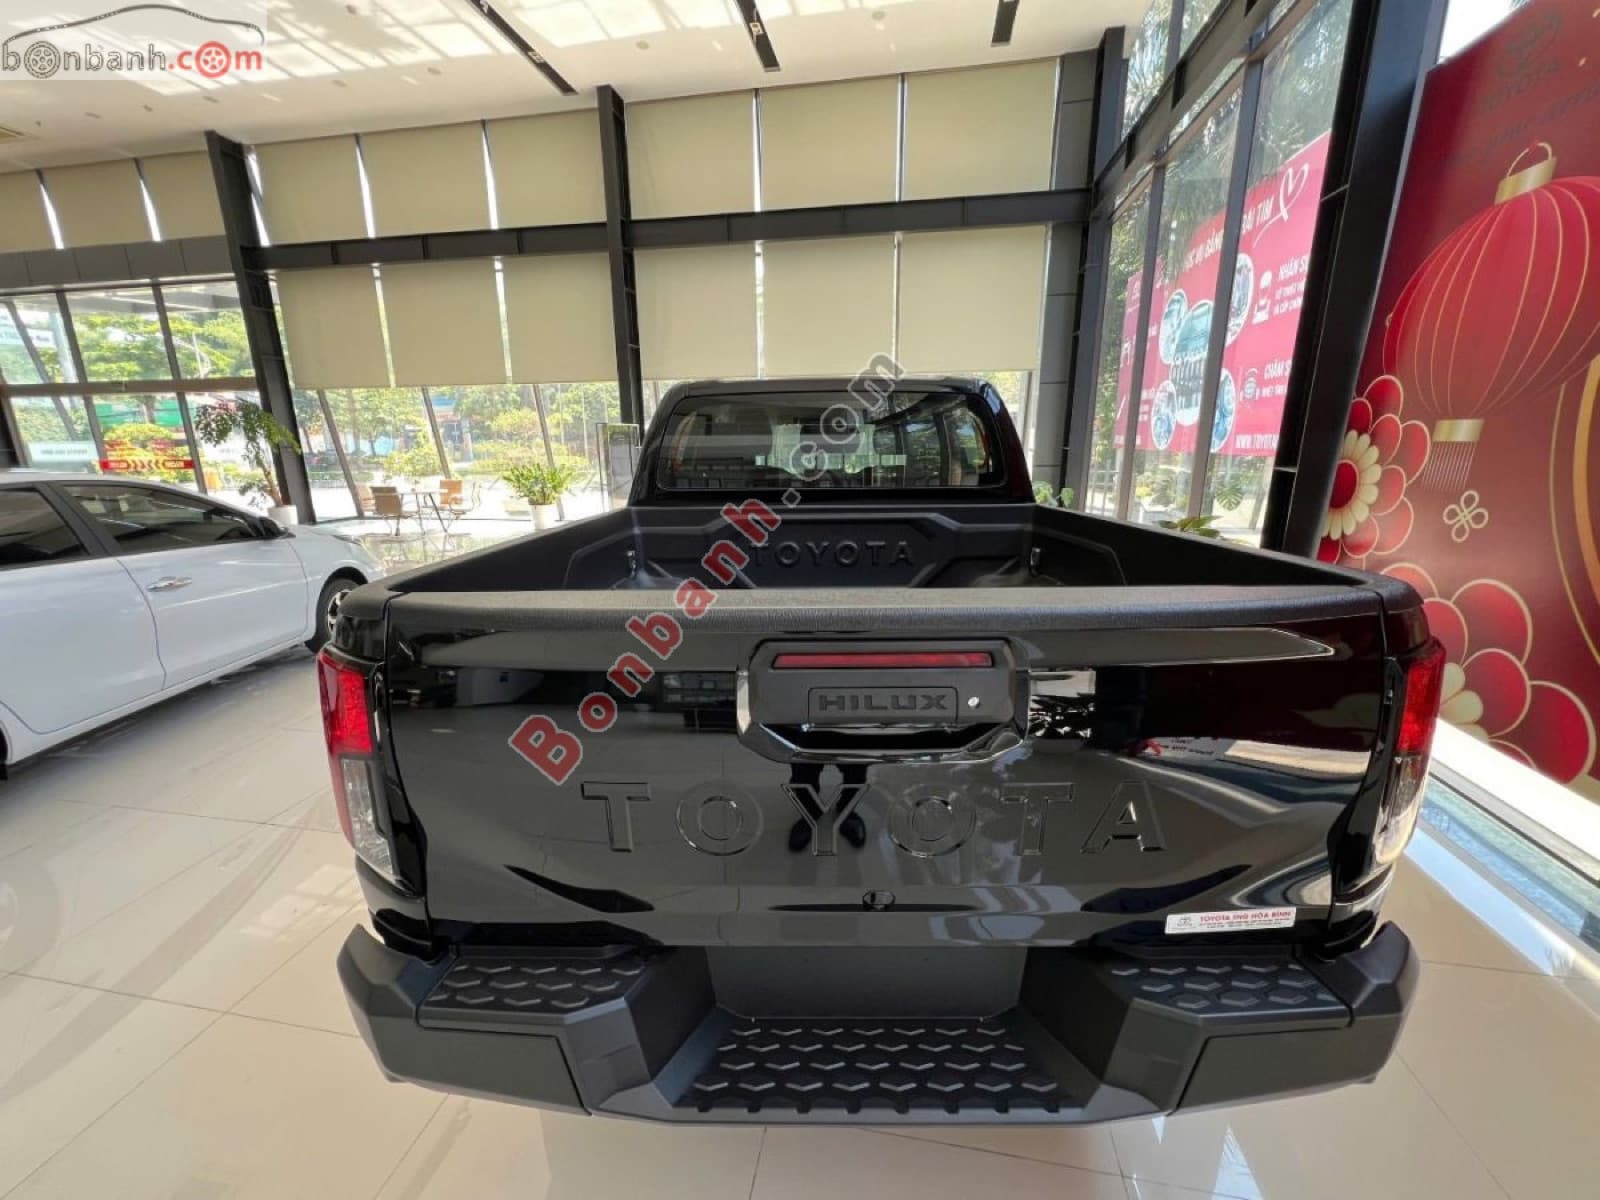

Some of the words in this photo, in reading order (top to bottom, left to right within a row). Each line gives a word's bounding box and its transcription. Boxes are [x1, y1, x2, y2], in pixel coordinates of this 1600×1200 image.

[752, 540, 914, 567] TOYOTA
[818, 694, 948, 711] HILUX
[580, 778, 1169, 857] TOYOTA
